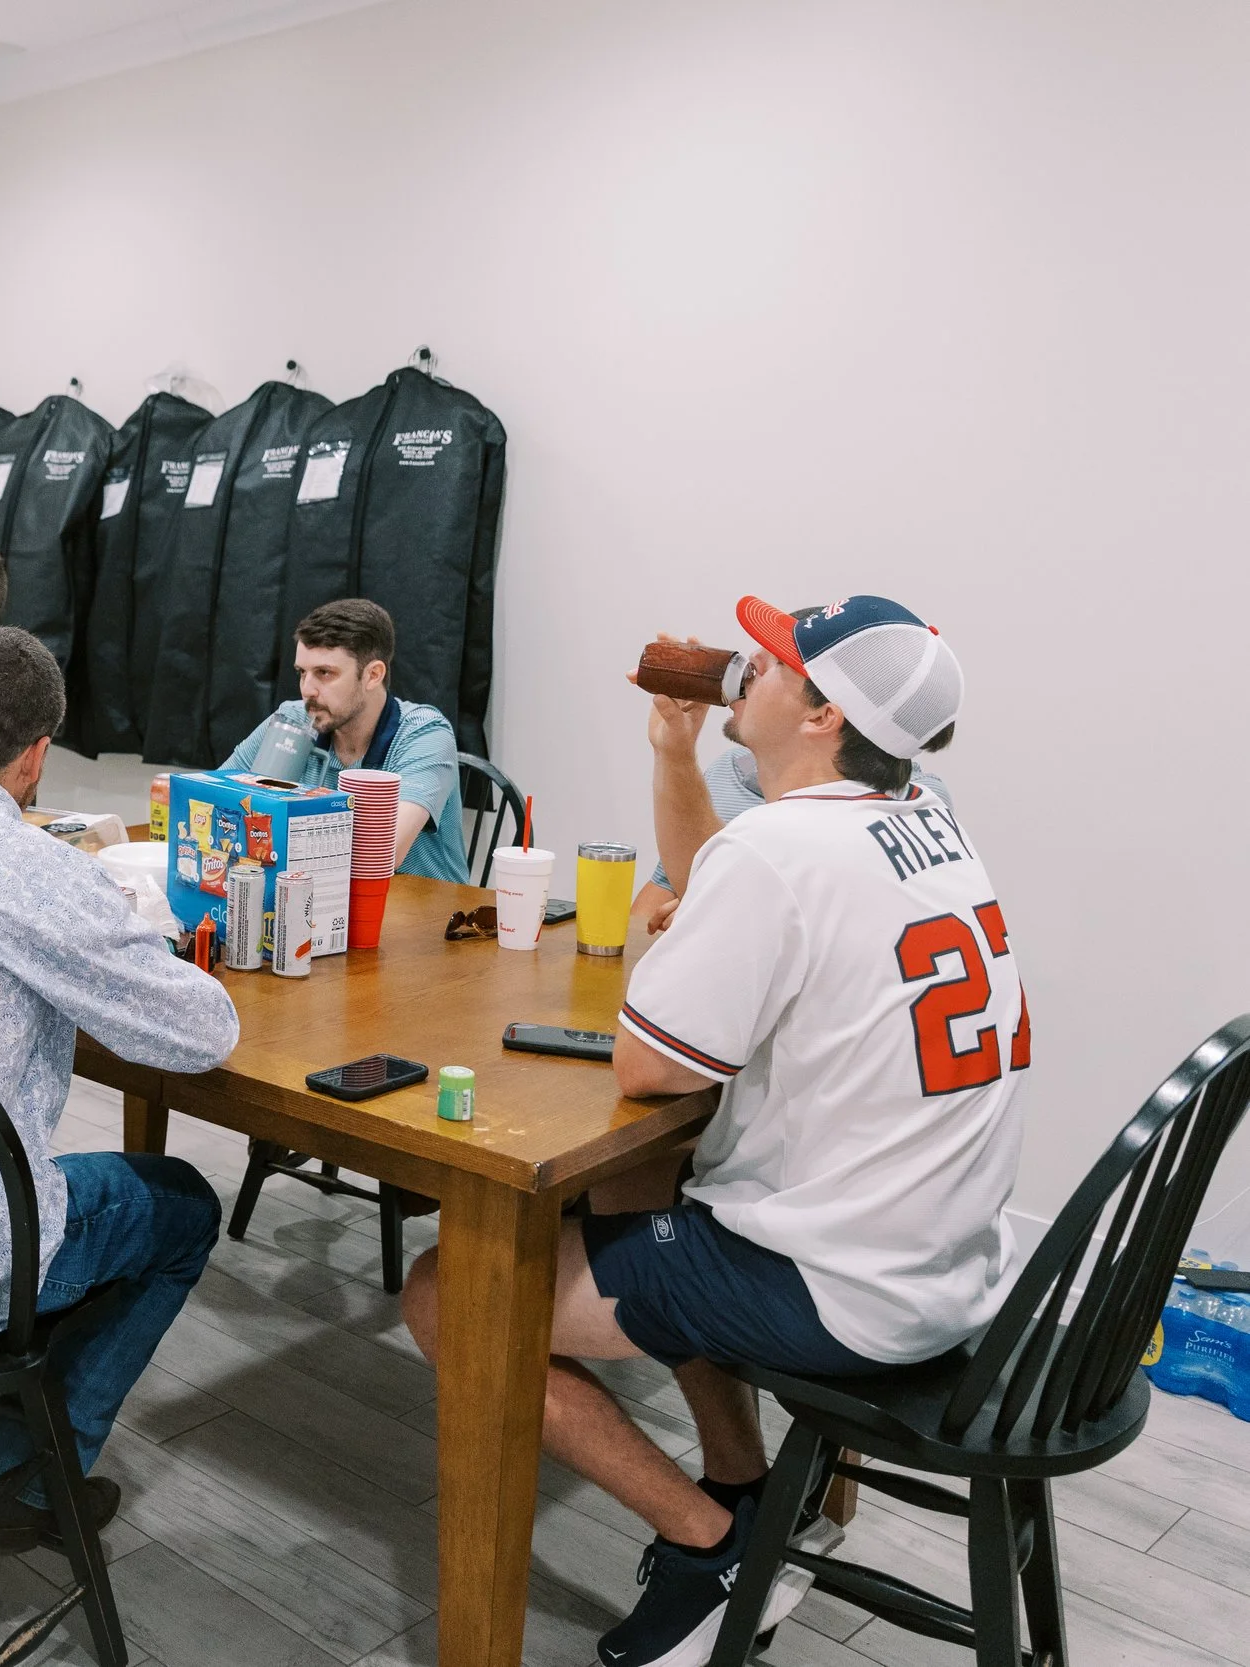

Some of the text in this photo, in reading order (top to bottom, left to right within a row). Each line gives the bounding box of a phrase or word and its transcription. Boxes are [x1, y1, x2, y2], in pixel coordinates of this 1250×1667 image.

[250, 830, 268, 838] Doritos
[866, 808, 974, 882] RILEY
[304, 892, 313, 917] WHIT
[894, 900, 1031, 1097] 27
